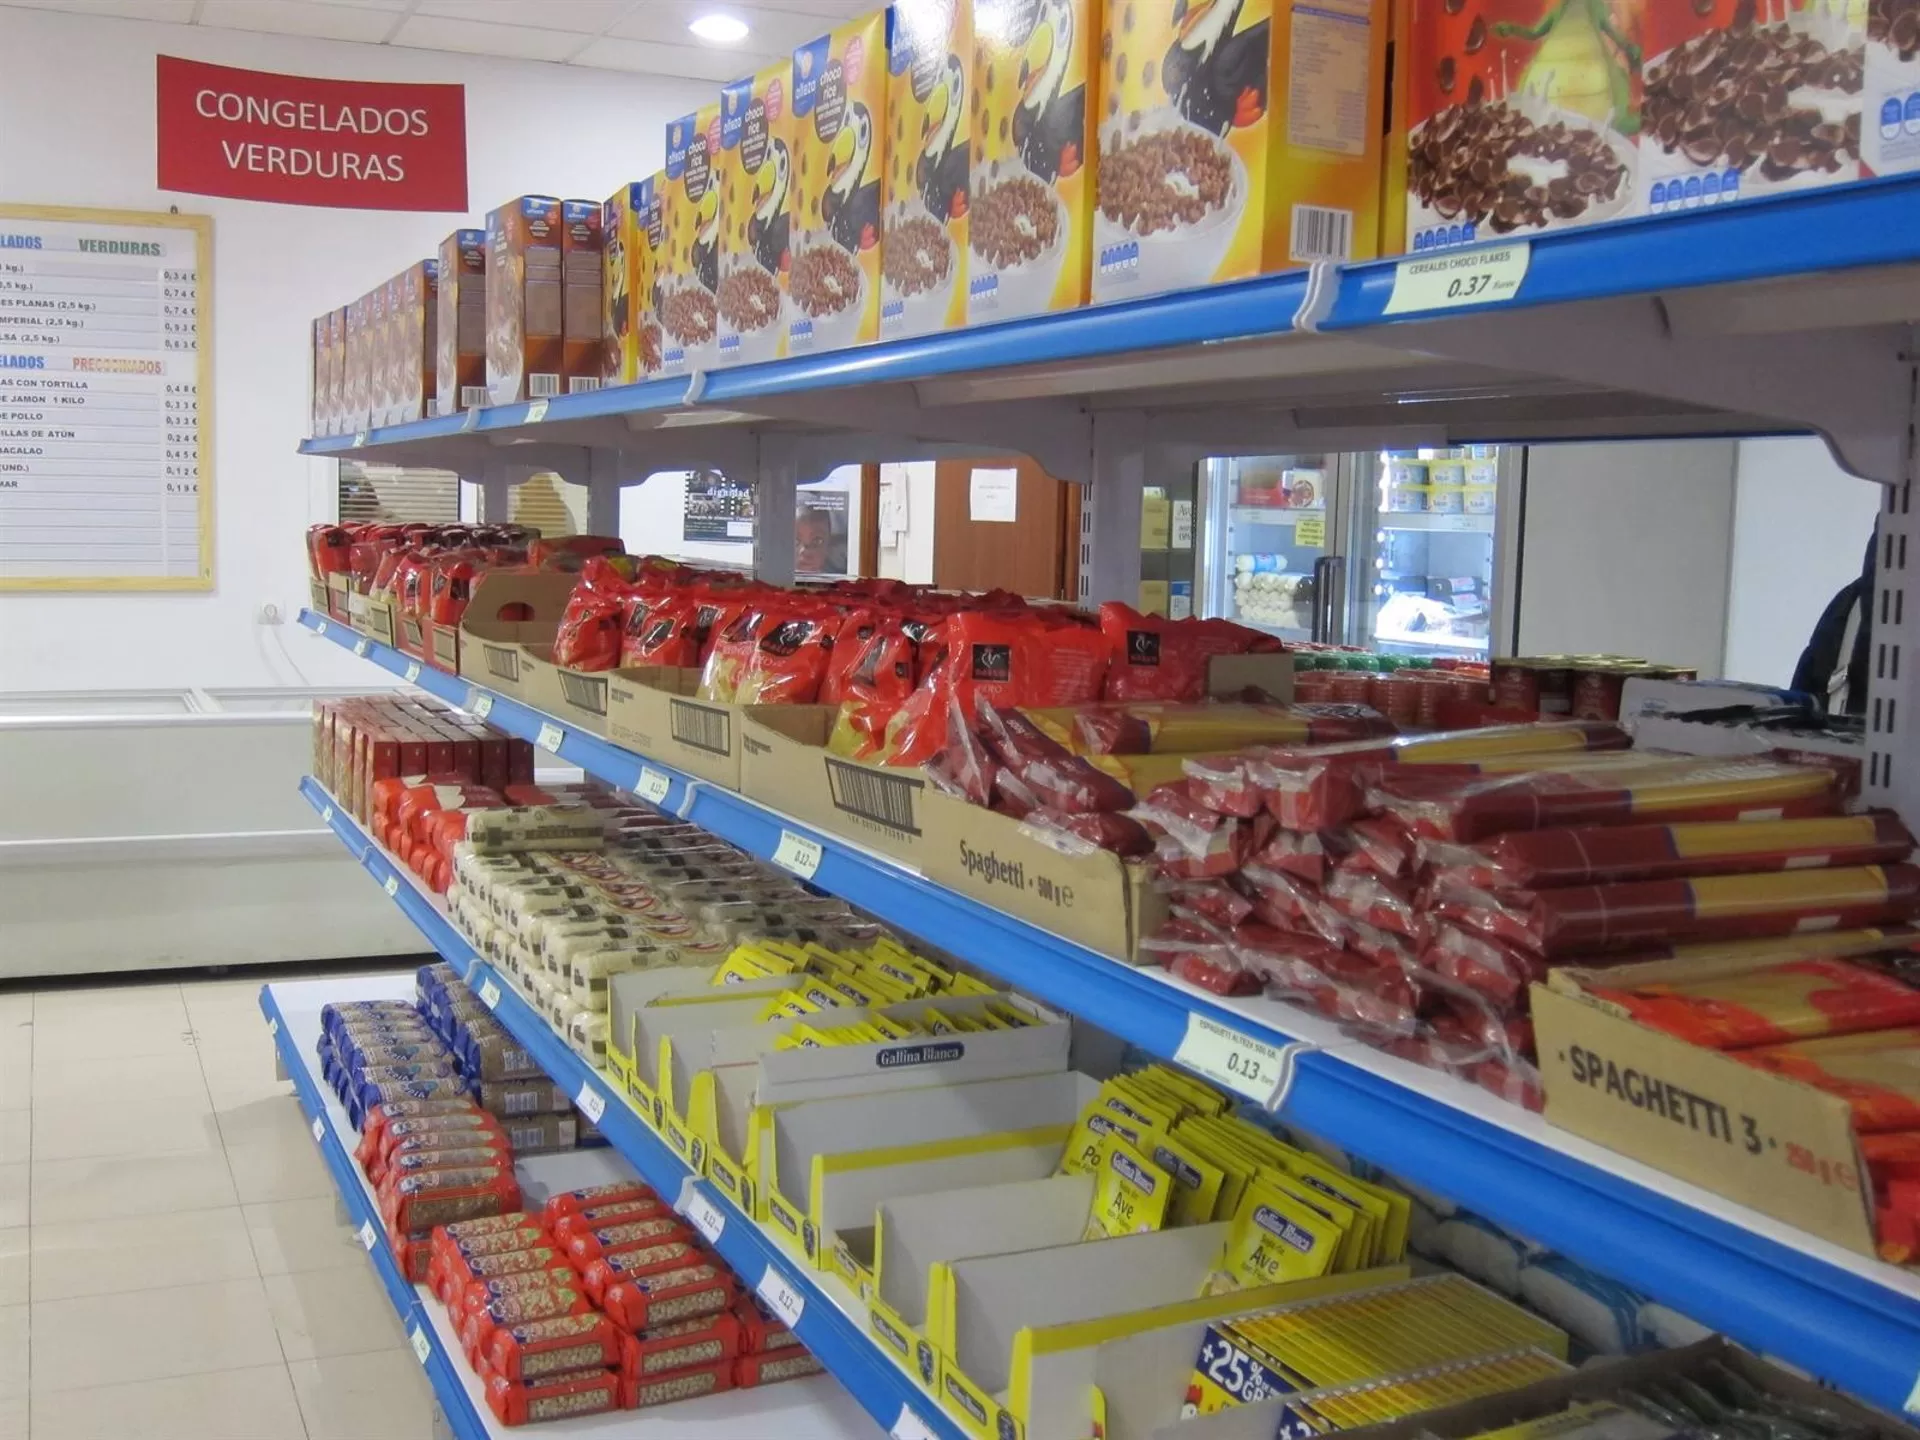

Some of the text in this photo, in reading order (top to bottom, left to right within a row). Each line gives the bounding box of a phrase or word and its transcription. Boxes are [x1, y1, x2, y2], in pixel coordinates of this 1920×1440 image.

[195, 89, 429, 137] CONGELADOS
[222, 140, 405, 182] VERDURAS
[79, 239, 161, 257] VERDURAS
[1409, 251, 1511, 275] CEREALES CHOCO FLAKES
[15, 282, 33, 291] kg.)
[1447, 274, 1492, 298] 0.37
[16, 300, 54, 308] PLANAS
[58, 301, 76, 310] (2,5
[78, 302, 96, 311] kg.)
[46, 318, 64, 326] (2,5
[66, 319, 84, 328] kg.)
[21, 334, 39, 343] (2,5
[42, 335, 60, 344] kg.)
[17, 379, 37, 388] CON
[40, 380, 88, 389] TORTILLA
[11, 396, 46, 404] JAMON
[959, 839, 1025, 891] Spaghetti
[881, 1046, 959, 1065] Gallina Blanca
[1227, 1052, 1261, 1080] 0.13
[1570, 1045, 1763, 1155] SPAGHETTI 3
[1113, 1191, 1135, 1220] Ave
[1250, 1245, 1279, 1276] Ave
